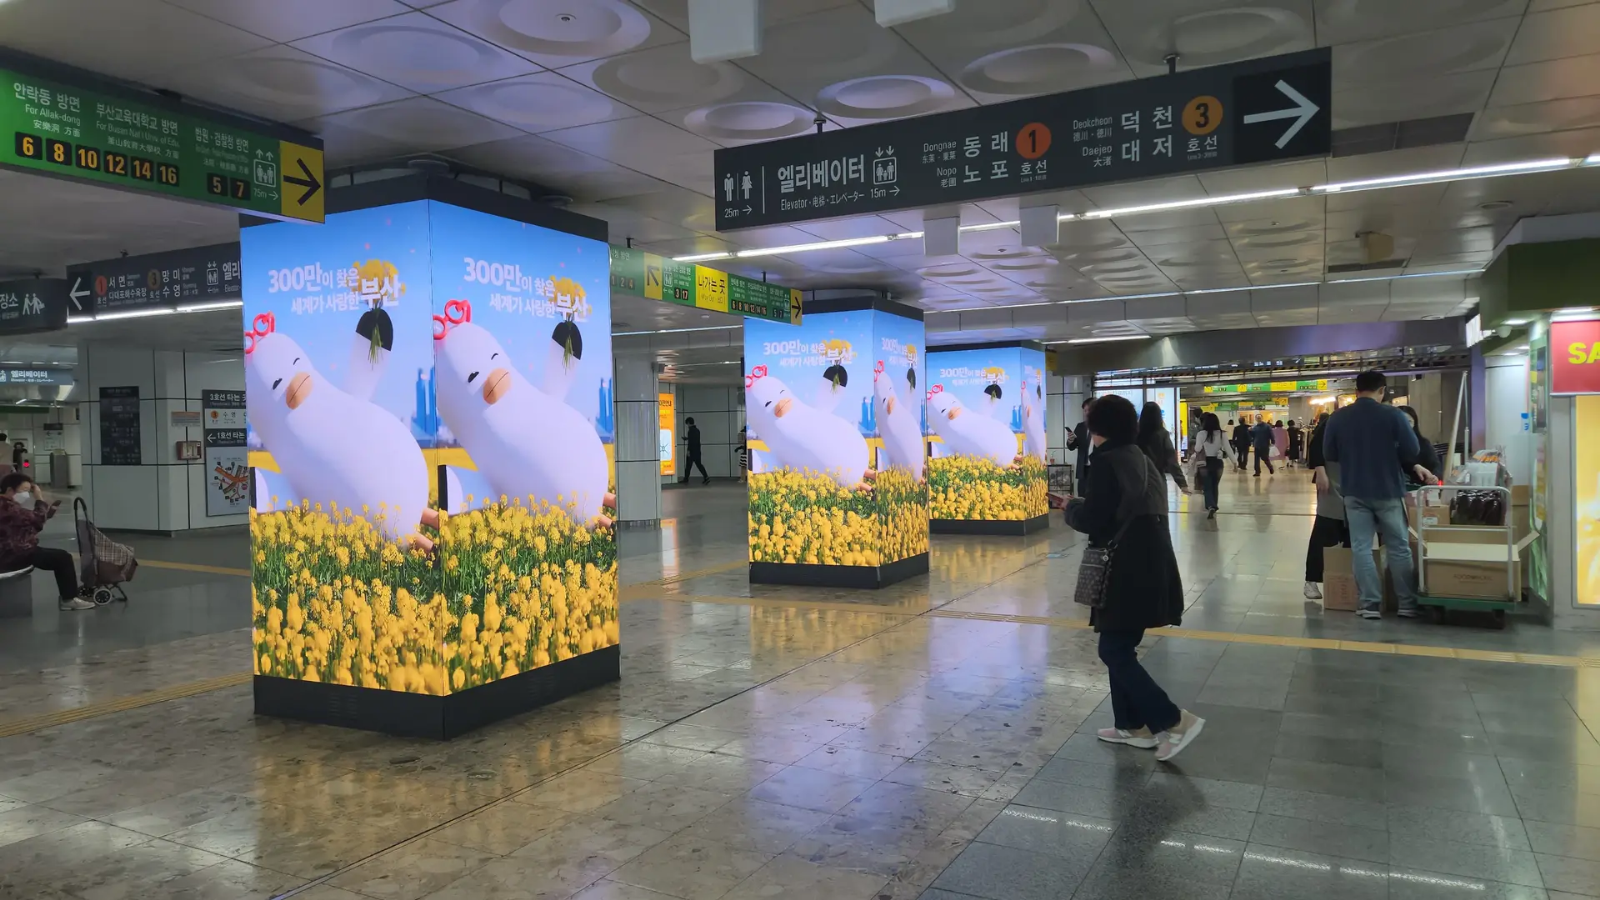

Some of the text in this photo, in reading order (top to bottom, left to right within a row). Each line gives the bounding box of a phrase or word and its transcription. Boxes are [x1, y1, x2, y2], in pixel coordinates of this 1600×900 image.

[14, 83, 80, 112] 안락동 방면
[25, 104, 80, 126] For Allak-dong
[96, 103, 178, 136] 부산교육대학교 방면
[1073, 116, 1113, 130] Deokcheon
[1195, 102, 1209, 128] 3
[64, 127, 80, 137] 方面
[1028, 129, 1037, 153] 1
[923, 141, 957, 153] Dongnae
[1082, 144, 1113, 157] Daejeo
[23, 137, 177, 184] 6 8 10 12 14 16
[777, 154, 864, 193] 엘리베이터
[937, 167, 957, 177] Nopo
[213, 176, 244, 197] 5 7
[870, 188, 886, 199] 15m
[724, 207, 739, 218] 25m
[781, 199, 807, 211] Elevator
[268, 261, 360, 293] 300만이 찾은
[463, 257, 556, 298] 300만이 찾은
[698, 274, 717, 293] 나가는
[719, 279, 726, 295] 곳
[360, 274, 401, 309] 부산
[291, 291, 360, 315] 세계가 사랑한
[489, 293, 556, 319] 세계가 사랑한
[556, 292, 589, 322] 부산
[763, 339, 809, 356] 300만이
[827, 346, 853, 365] 부산
[10, 370, 48, 379] 엘리베이터
